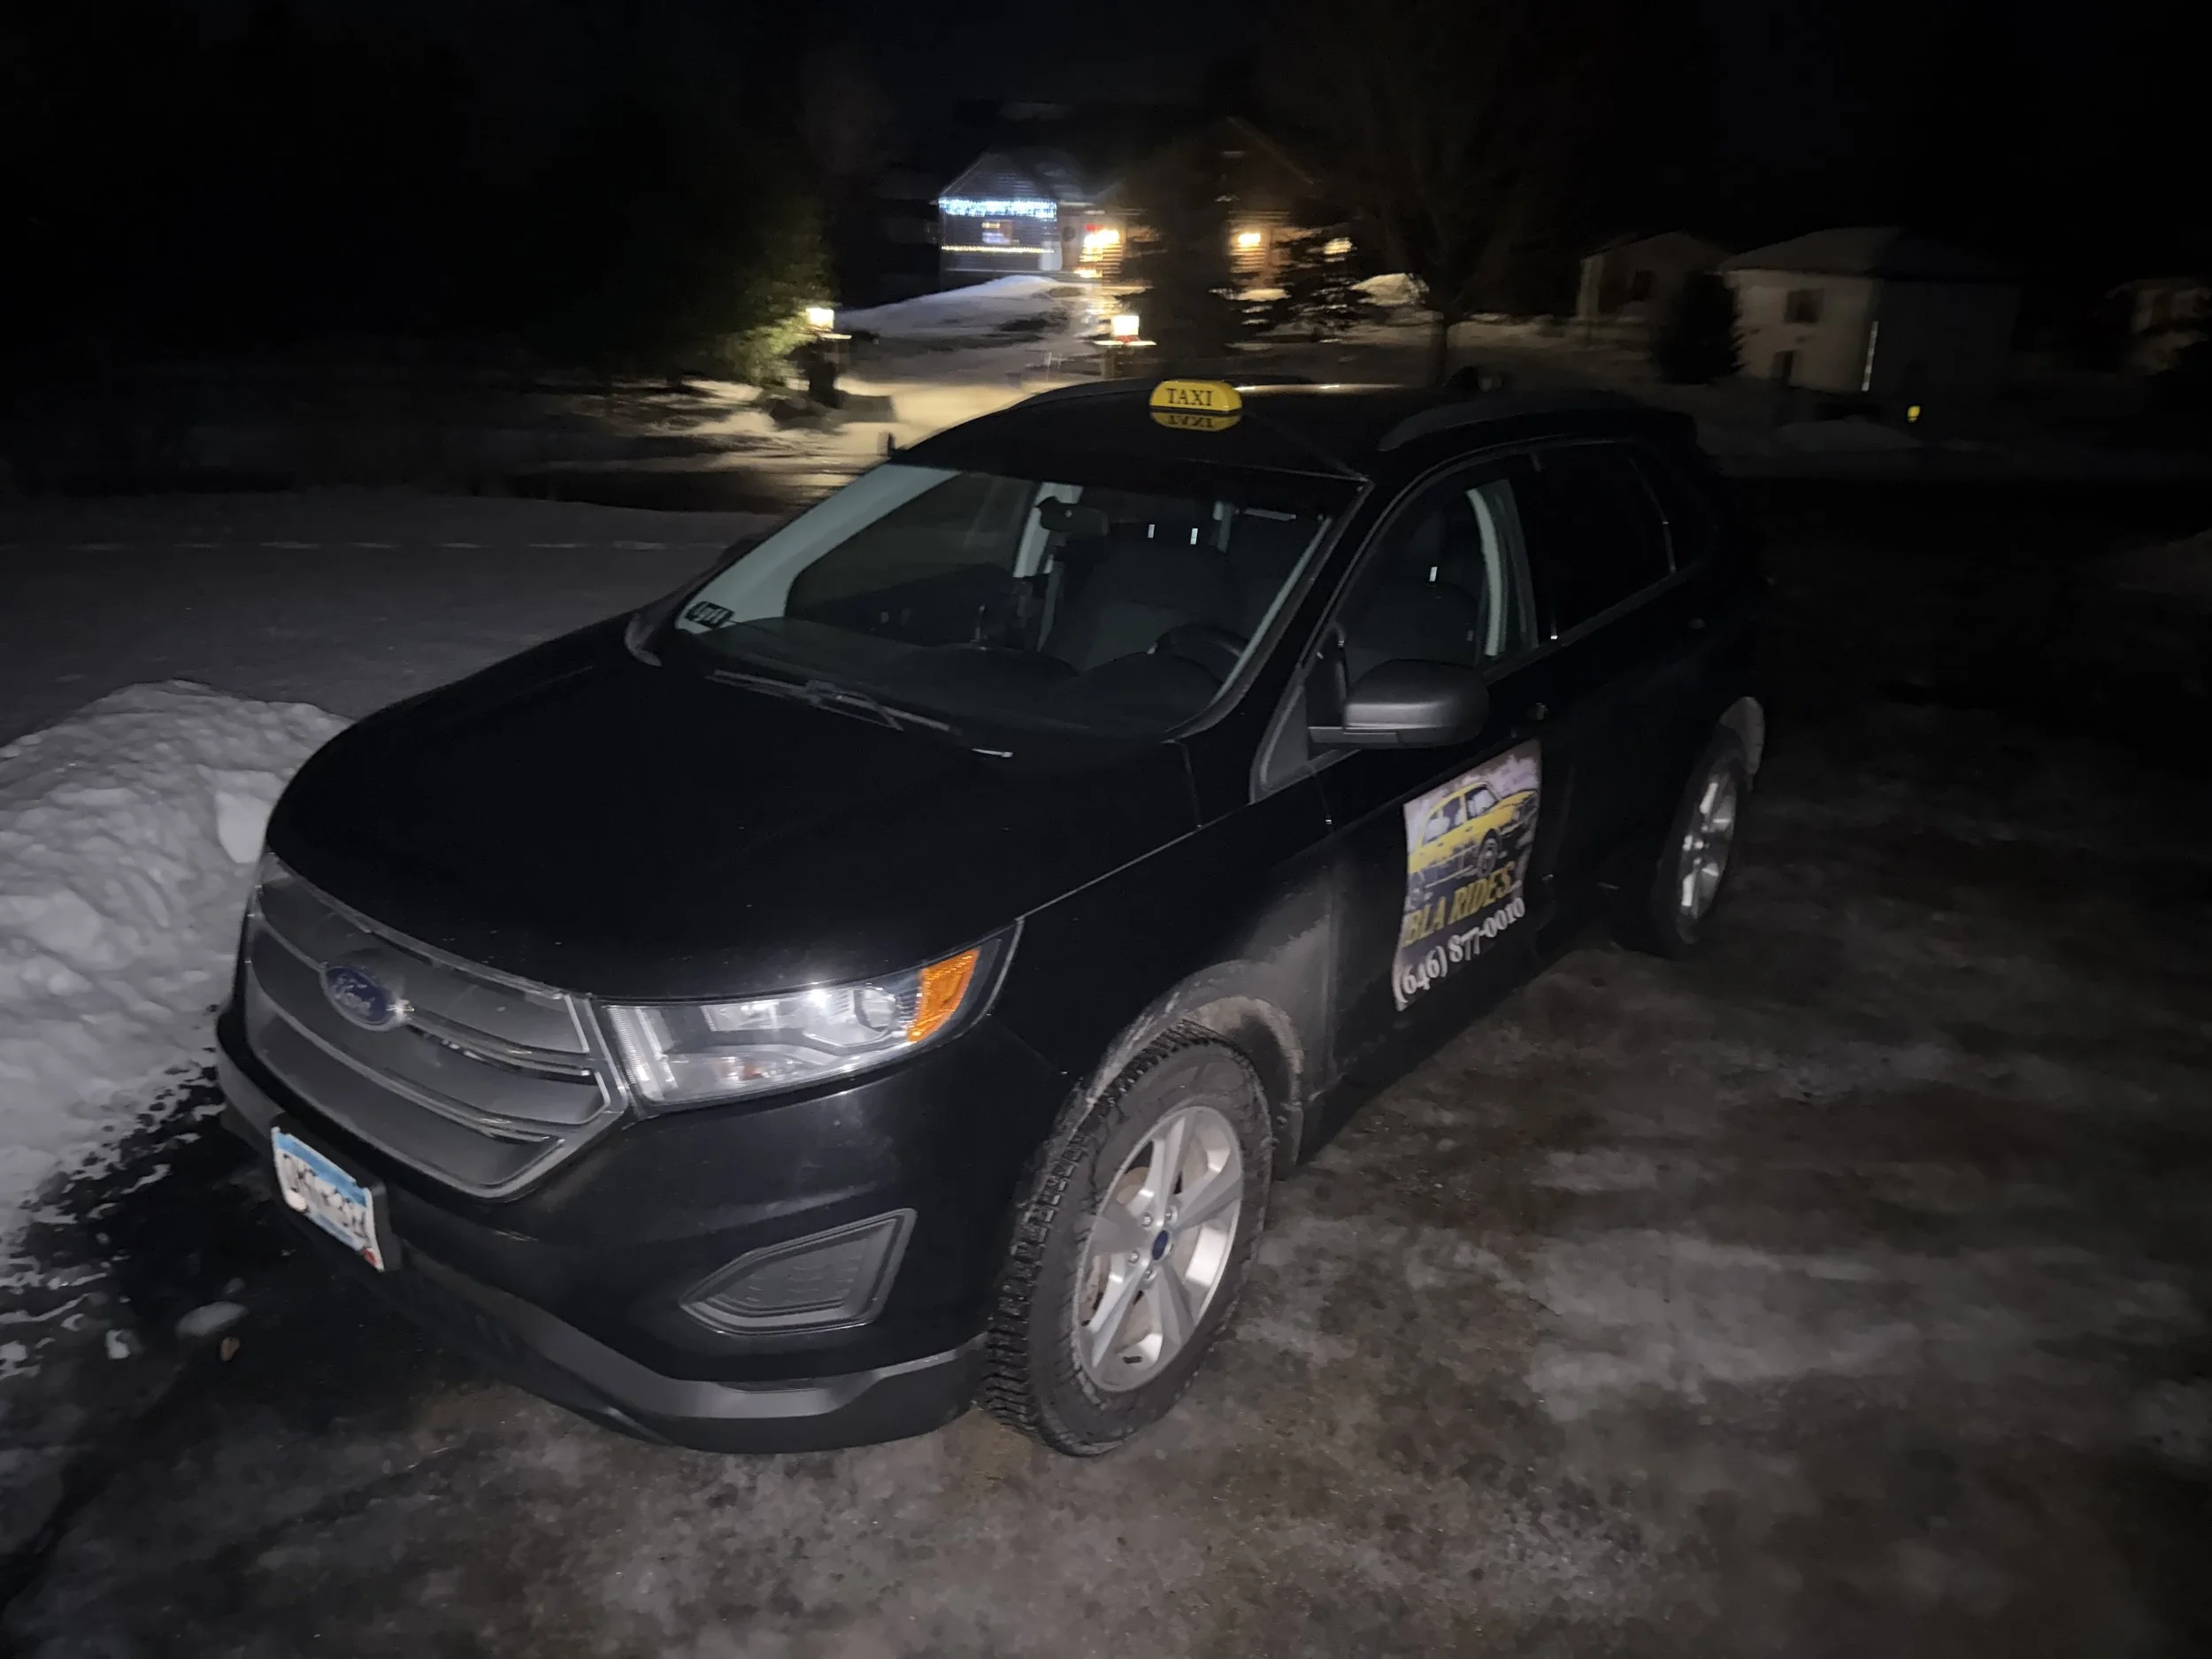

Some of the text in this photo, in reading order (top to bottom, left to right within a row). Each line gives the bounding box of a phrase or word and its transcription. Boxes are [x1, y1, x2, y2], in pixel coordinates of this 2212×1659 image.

[1165, 388, 1213, 406] TAXI
[1403, 896, 1447, 945] BLA
[1392, 897, 1525, 1003] (646) 877-0010
